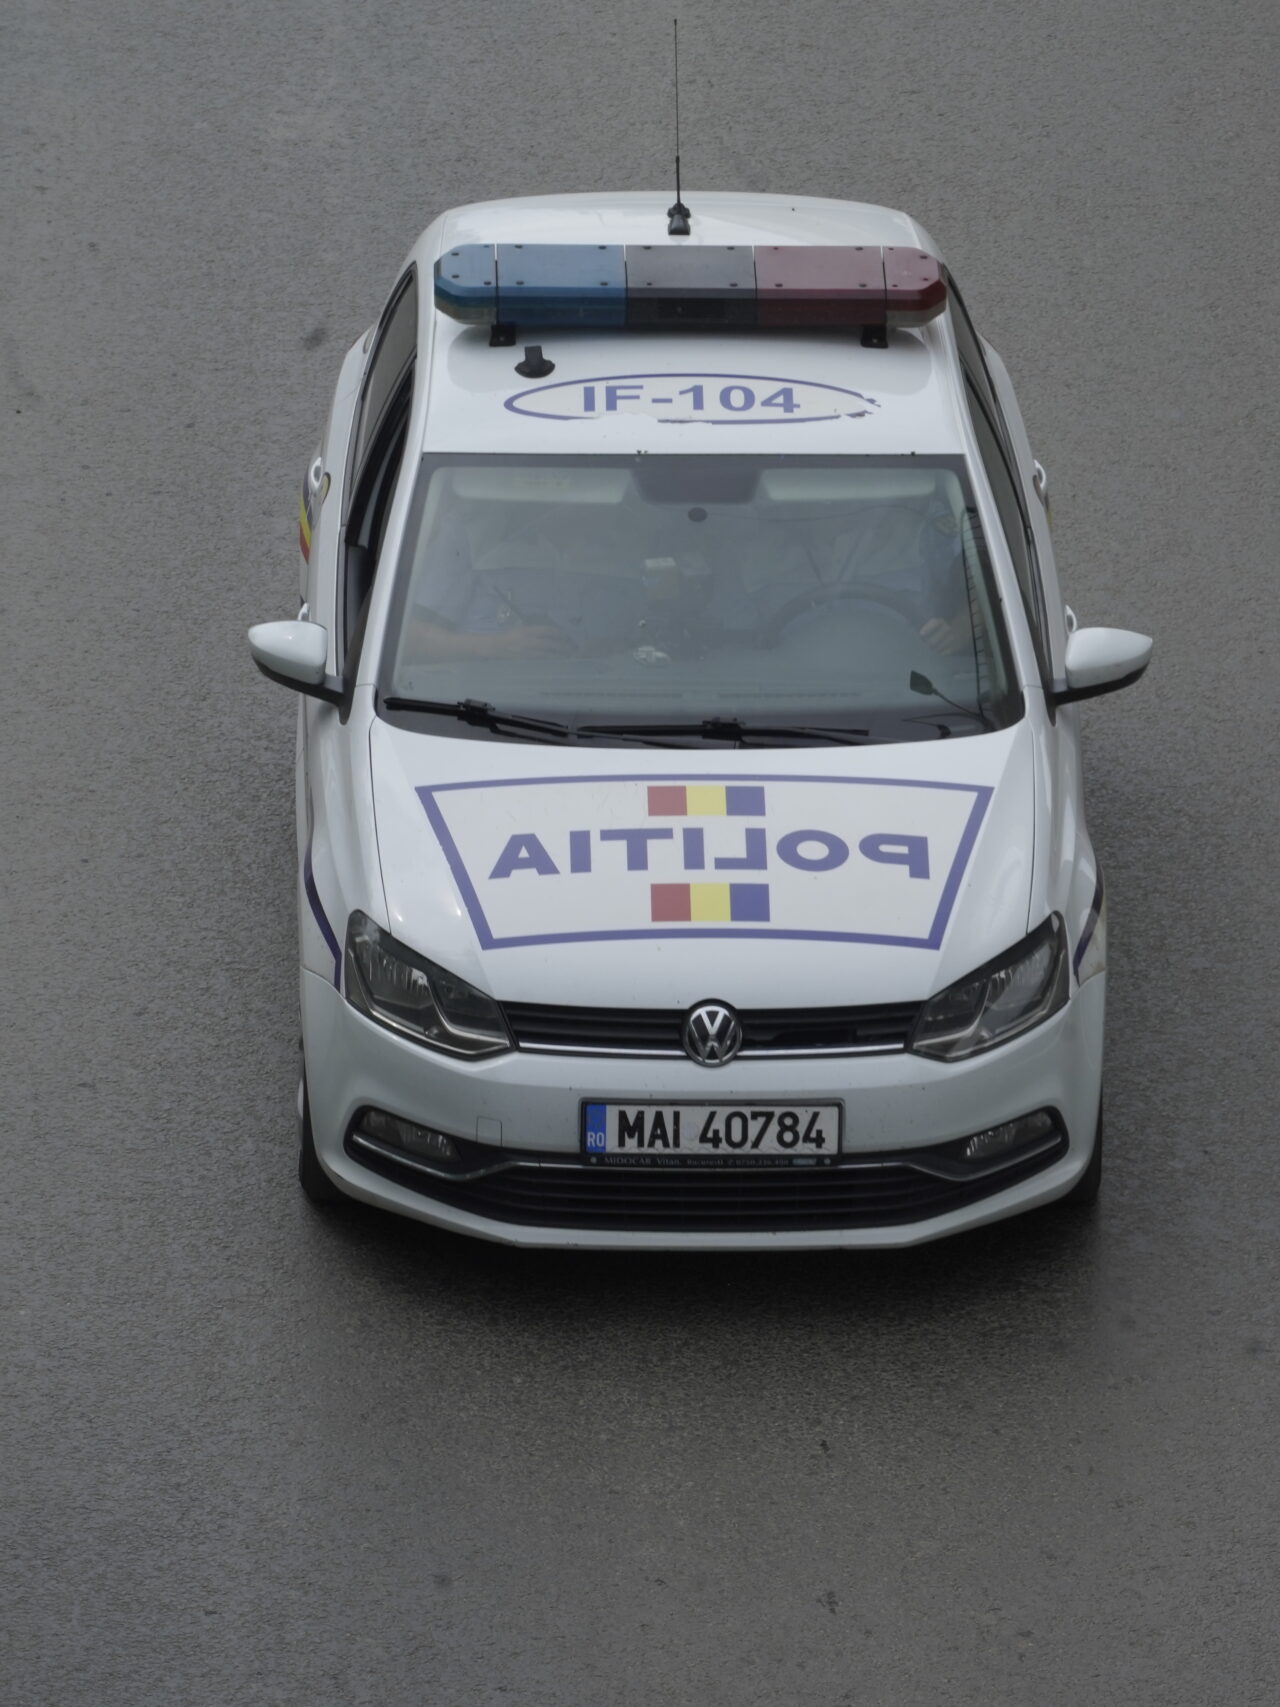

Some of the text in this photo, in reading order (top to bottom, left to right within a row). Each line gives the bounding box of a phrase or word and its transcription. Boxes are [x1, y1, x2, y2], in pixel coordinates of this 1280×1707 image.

[583, 384, 801, 414] IF-104
[586, 1131, 606, 1148] RO
[617, 1109, 826, 1150] MAI 40784
